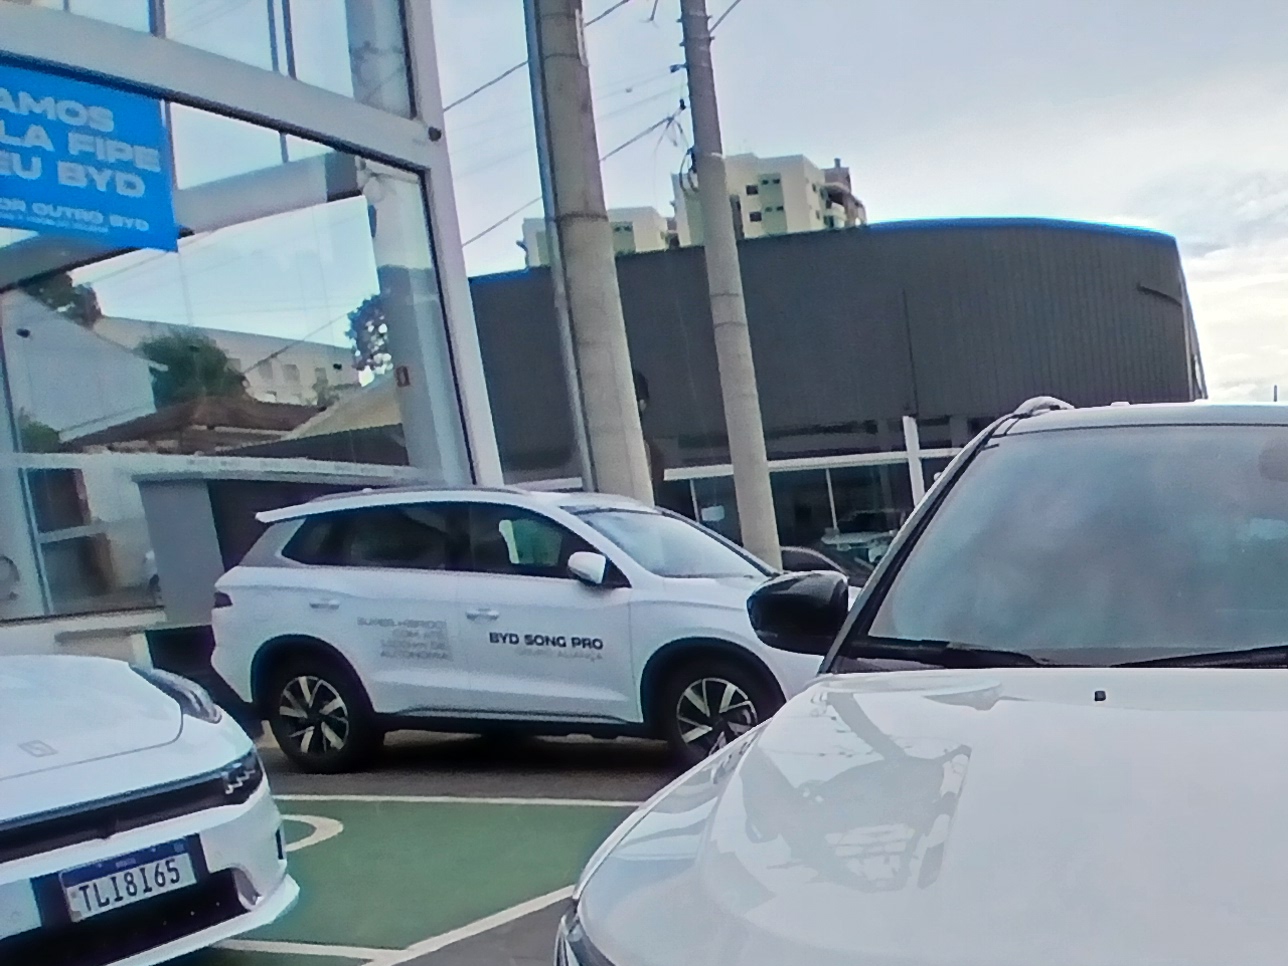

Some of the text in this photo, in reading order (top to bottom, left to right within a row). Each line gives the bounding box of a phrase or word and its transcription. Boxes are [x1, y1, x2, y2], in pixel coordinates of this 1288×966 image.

[68, 132, 161, 173] FIPE
[57, 160, 146, 198] BYD
[489, 632, 604, 650] BYD SONG PRO
[78, 858, 181, 911] TLI8I65
